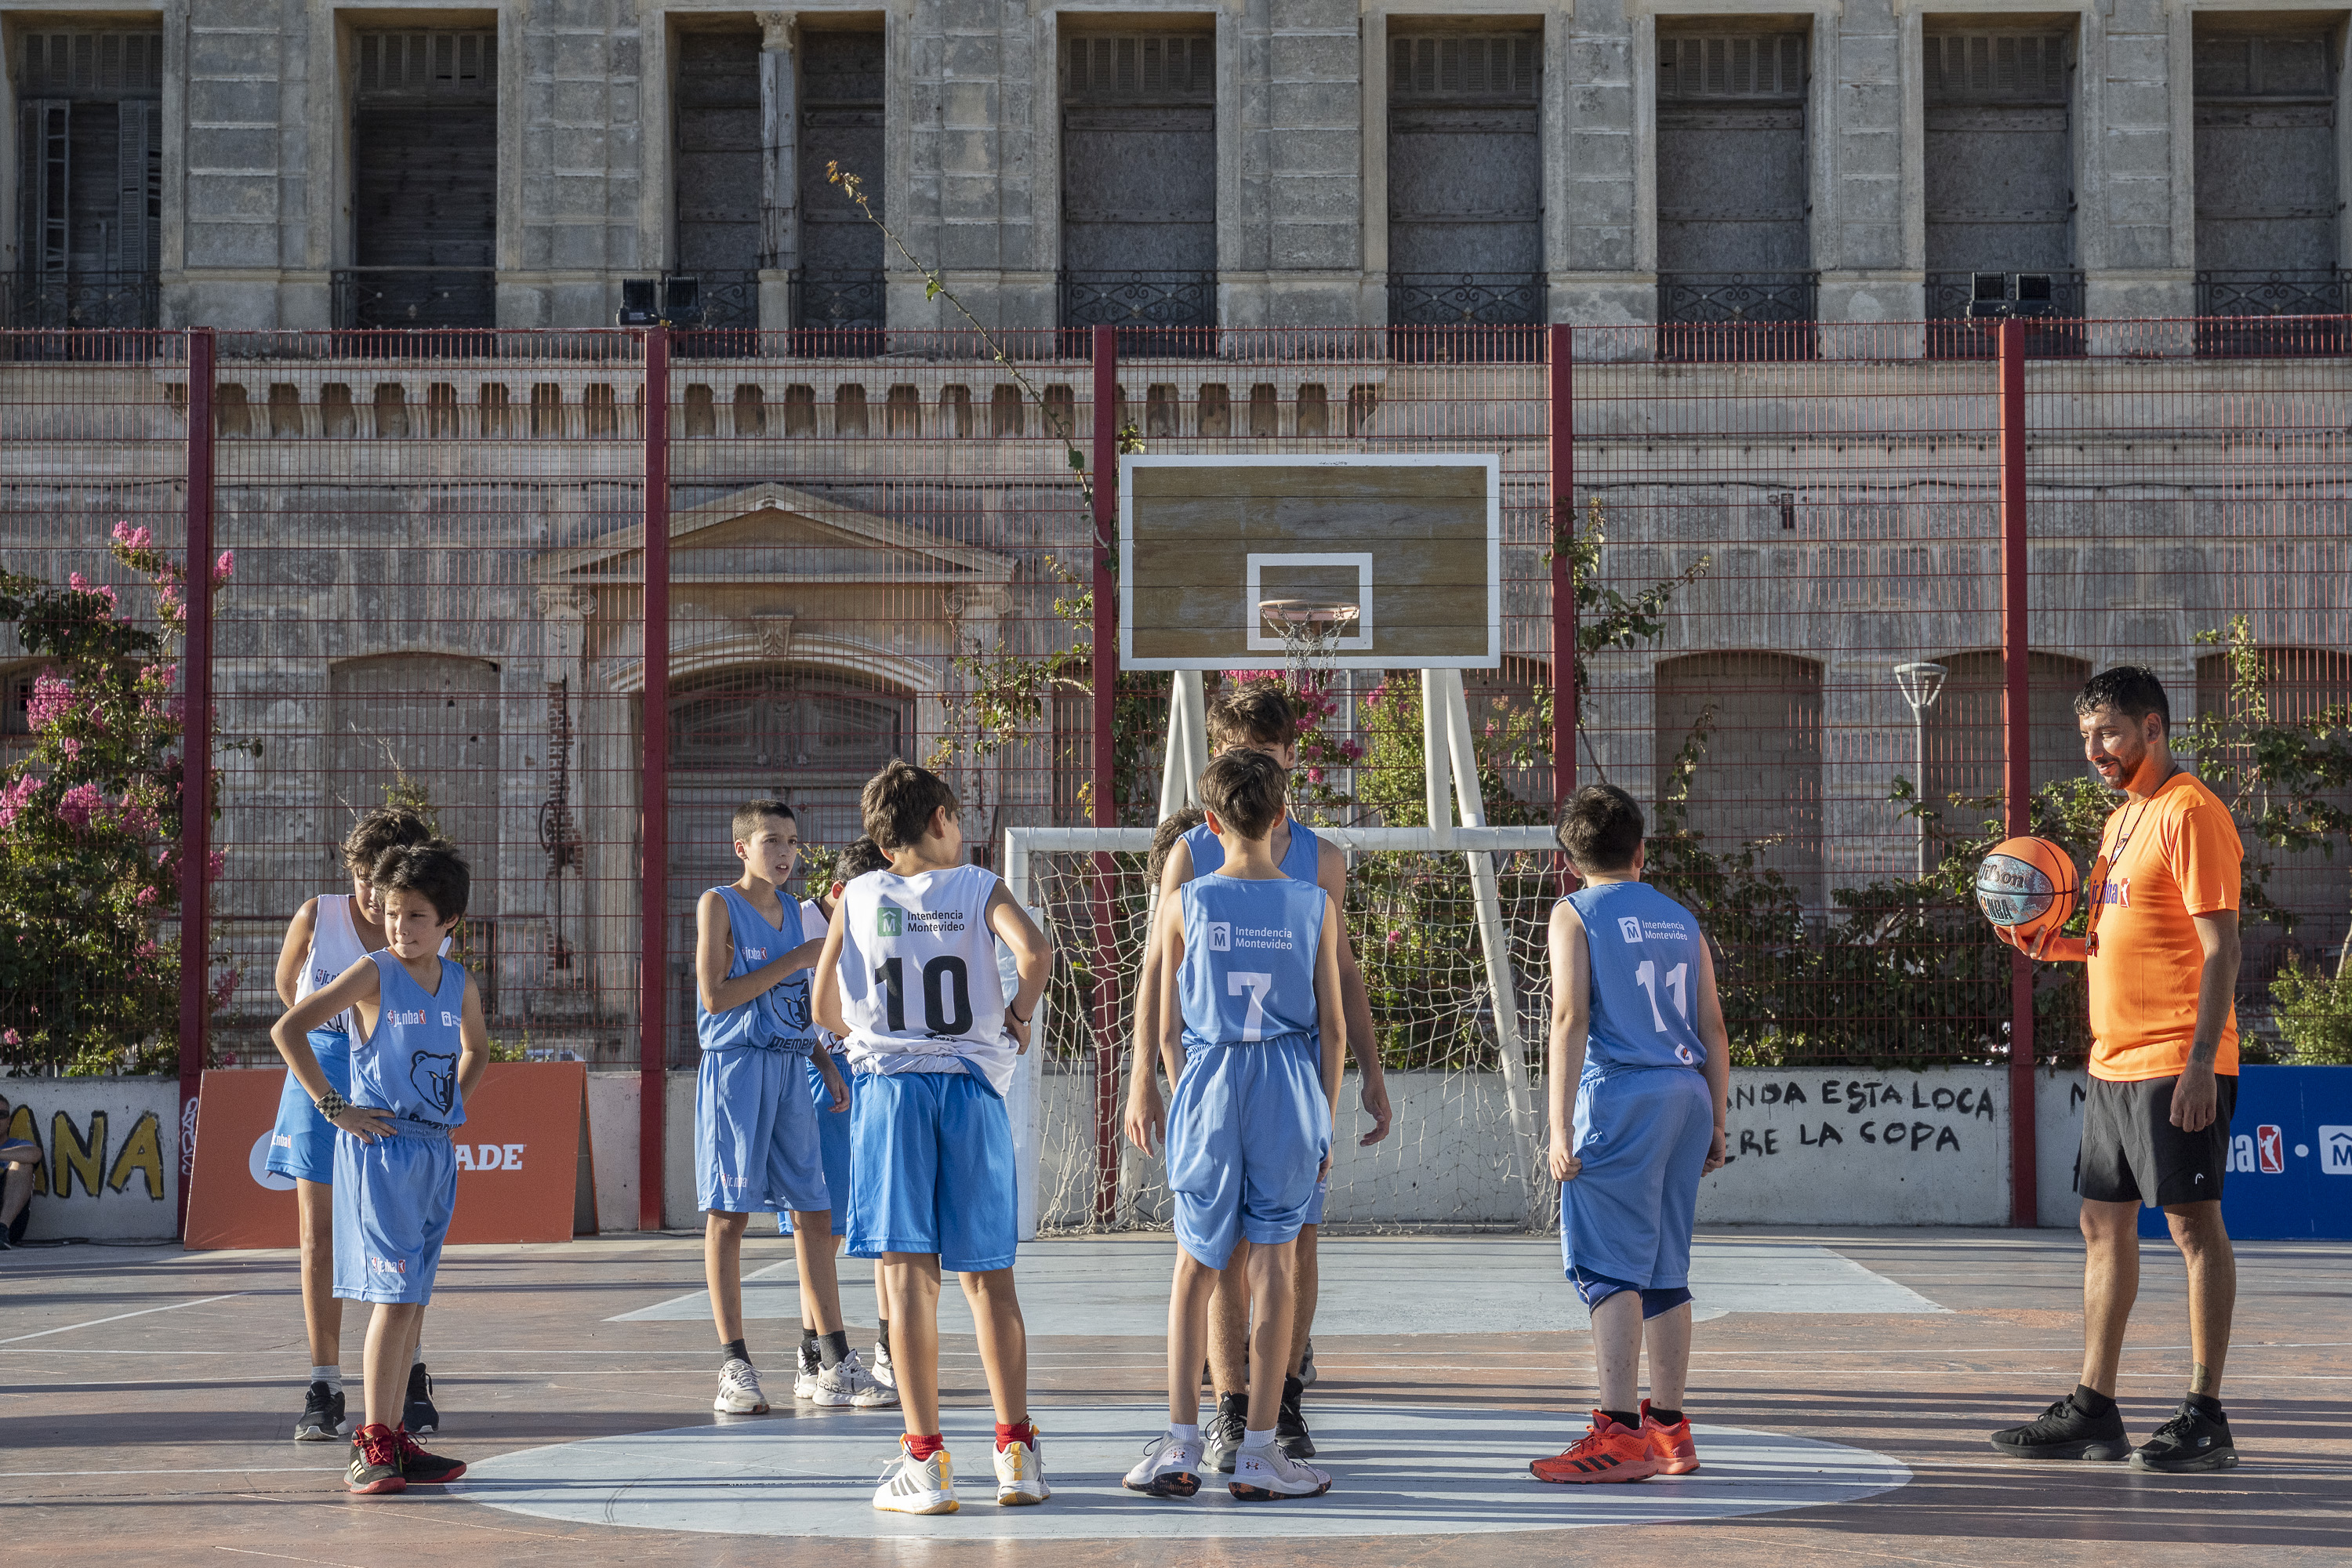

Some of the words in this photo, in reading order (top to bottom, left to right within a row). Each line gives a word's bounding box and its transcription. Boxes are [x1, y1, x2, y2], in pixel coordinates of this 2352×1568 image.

[907, 909, 964, 921] Intendencia
[907, 921, 965, 932] Montevideo
[1642, 920, 1685, 931] Intendencia
[1235, 926, 1292, 938] Intendencia
[1645, 930, 1688, 941] Montevideo
[1235, 938, 1293, 949] Montevideo
[874, 955, 973, 1035] 10
[1635, 960, 1690, 1033] 11
[1227, 971, 1272, 1041] 7
[1821, 1080, 1903, 1114] ESTA
[1911, 1080, 1994, 1122] LOCA
[1800, 1121, 1843, 1148] LA
[1860, 1121, 1960, 1152] COPA
